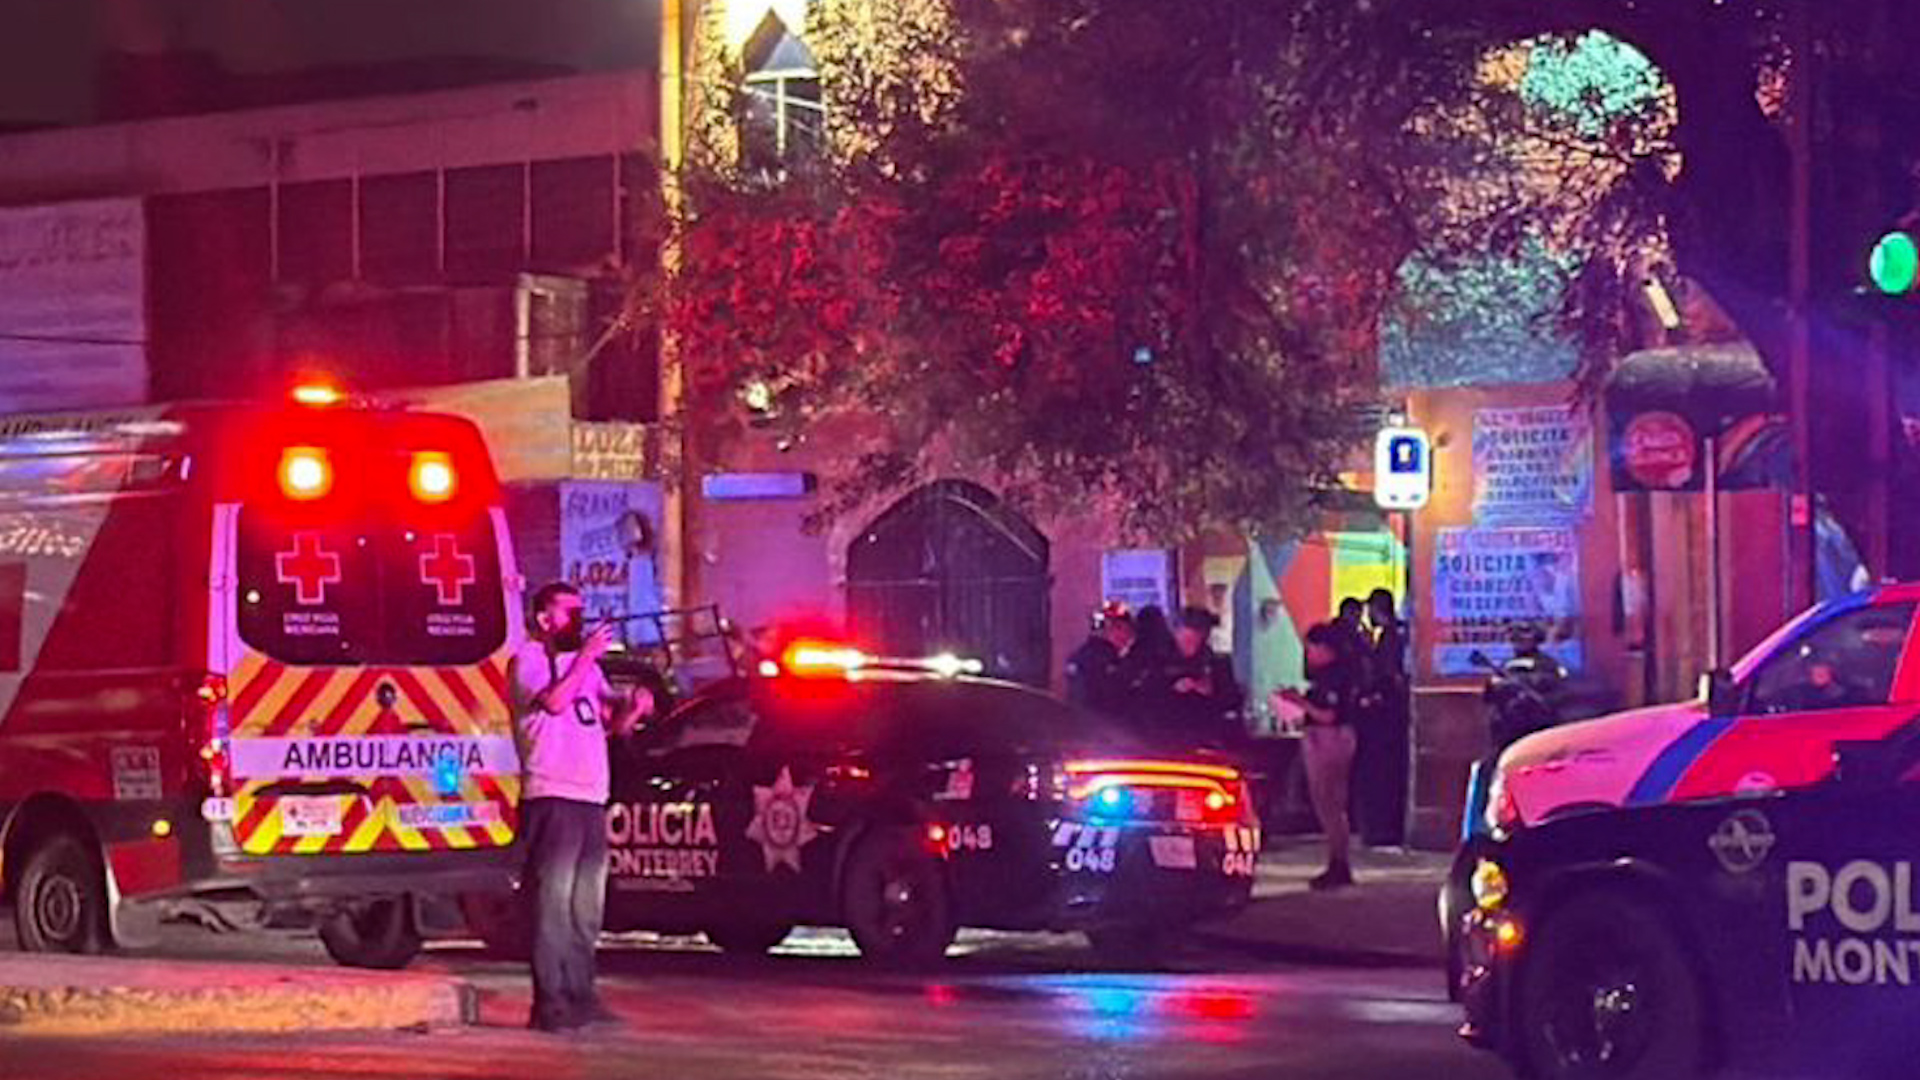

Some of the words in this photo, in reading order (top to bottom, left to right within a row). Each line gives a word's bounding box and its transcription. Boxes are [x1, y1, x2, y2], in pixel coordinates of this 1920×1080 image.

[1439, 554, 1526, 574] SOLICITA
[283, 741, 484, 770] AMBULANCIA
[606, 801, 718, 846] OLICIA
[948, 825, 992, 850] 048
[608, 848, 719, 876] ONTERREY
[1066, 848, 1115, 872] 048
